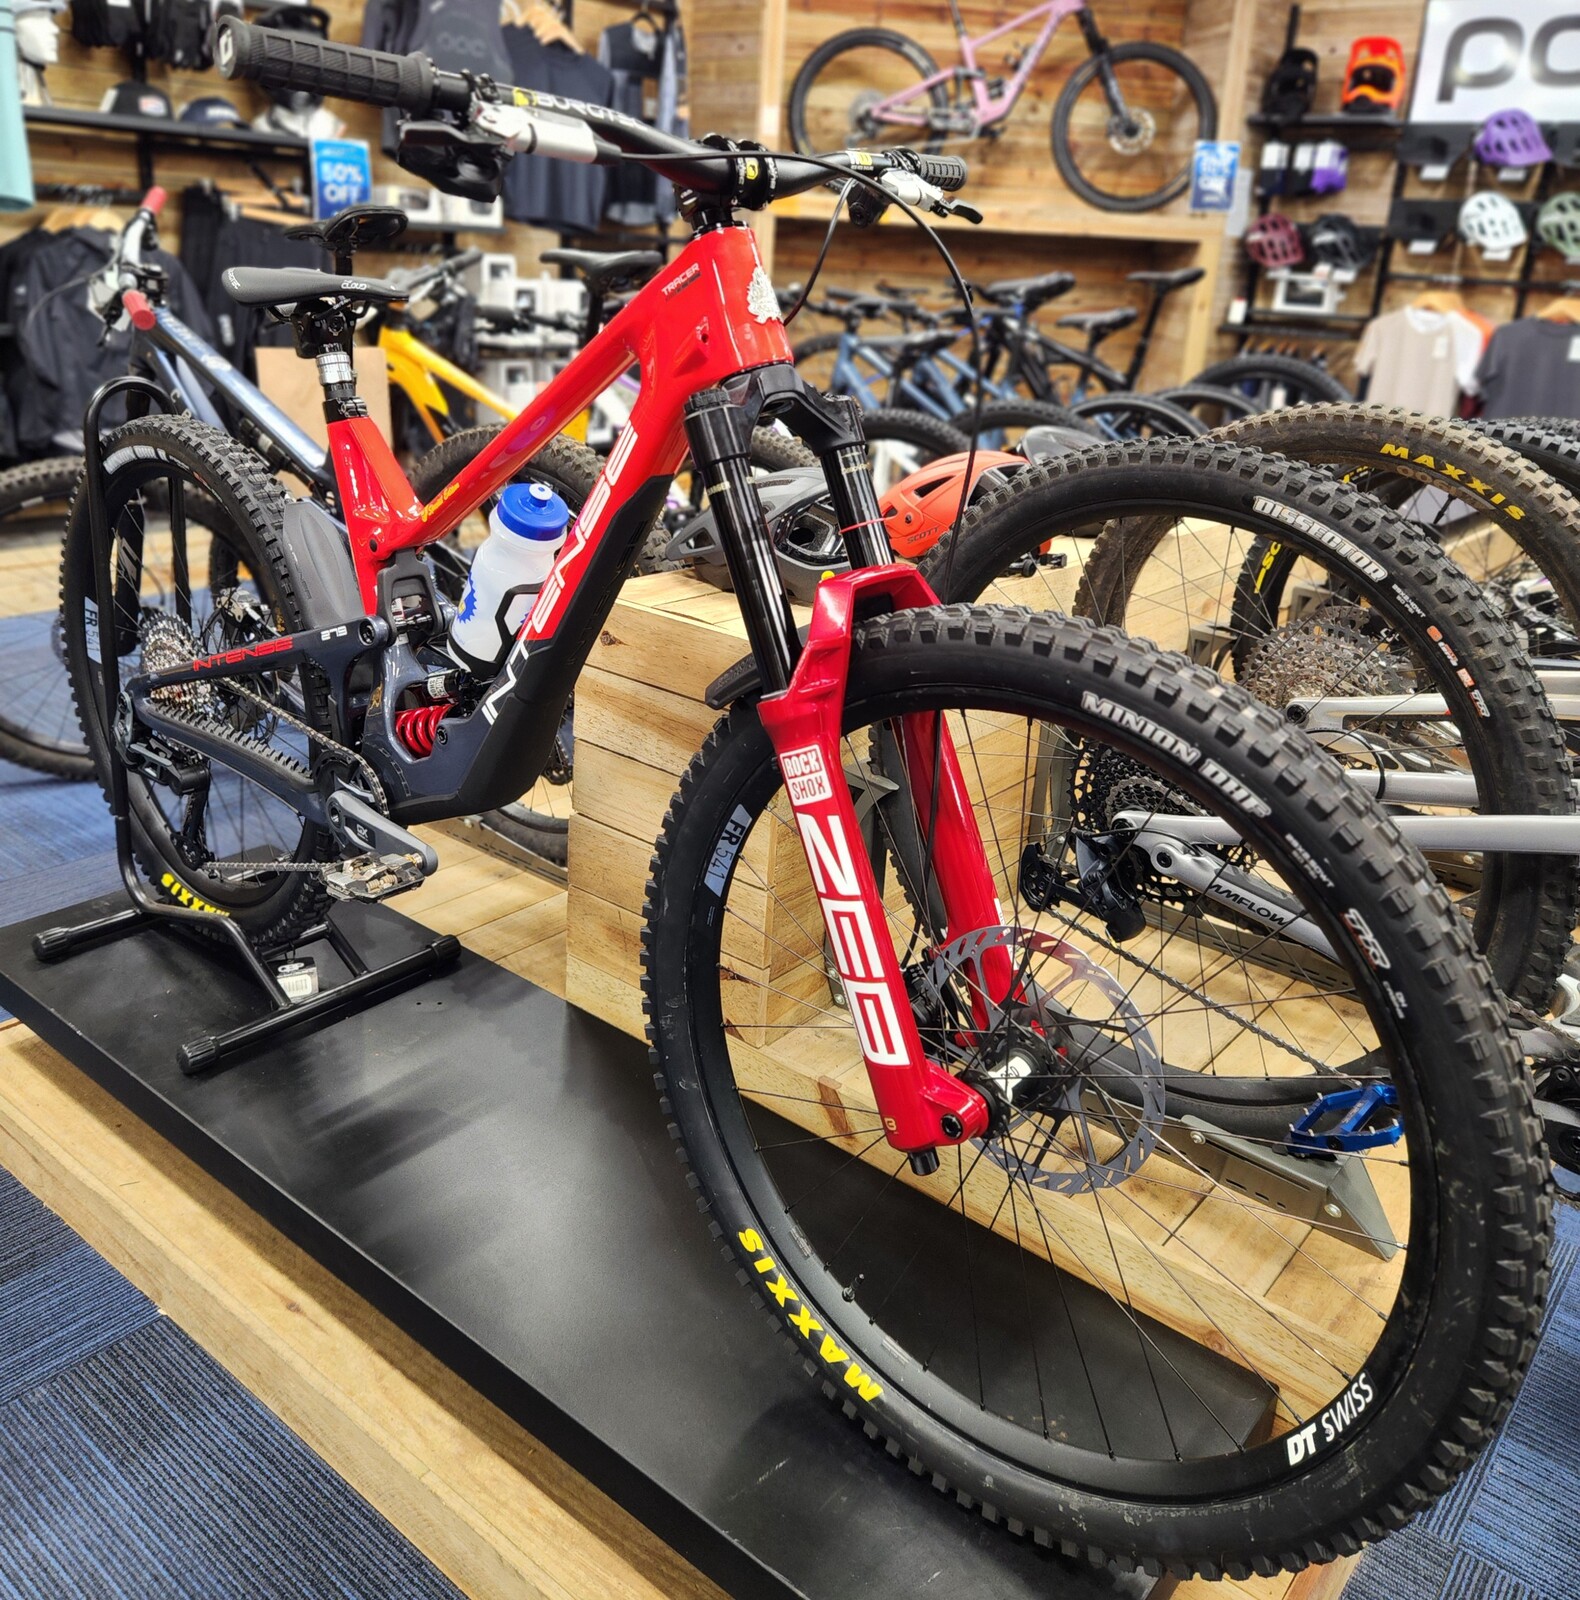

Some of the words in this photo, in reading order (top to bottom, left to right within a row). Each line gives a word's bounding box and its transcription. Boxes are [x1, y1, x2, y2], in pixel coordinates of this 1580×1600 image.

[320, 161, 363, 183] 50%
[323, 183, 360, 204] OFF
[661, 262, 700, 296] TRACER
[1380, 443, 1526, 520] MAXXIS
[906, 526, 940, 544] SCOTT
[1253, 495, 1388, 583] DISSECTOR
[481, 420, 638, 726] INTENSE
[84, 607, 98, 627] FR
[192, 636, 294, 671] INTENSE
[784, 750, 821, 780] ROCK
[1080, 690, 1202, 767] MINION
[1199, 757, 1272, 818] DHF
[792, 776, 827, 800] SHOX
[356, 823, 369, 838] GX
[720, 818, 747, 846] FR
[706, 846, 734, 881] 541
[796, 811, 912, 1067] ZEB
[738, 1227, 884, 1402] MAXXIS
[1286, 1422, 1317, 1467] DT
[1321, 1372, 1374, 1443] SWISS
